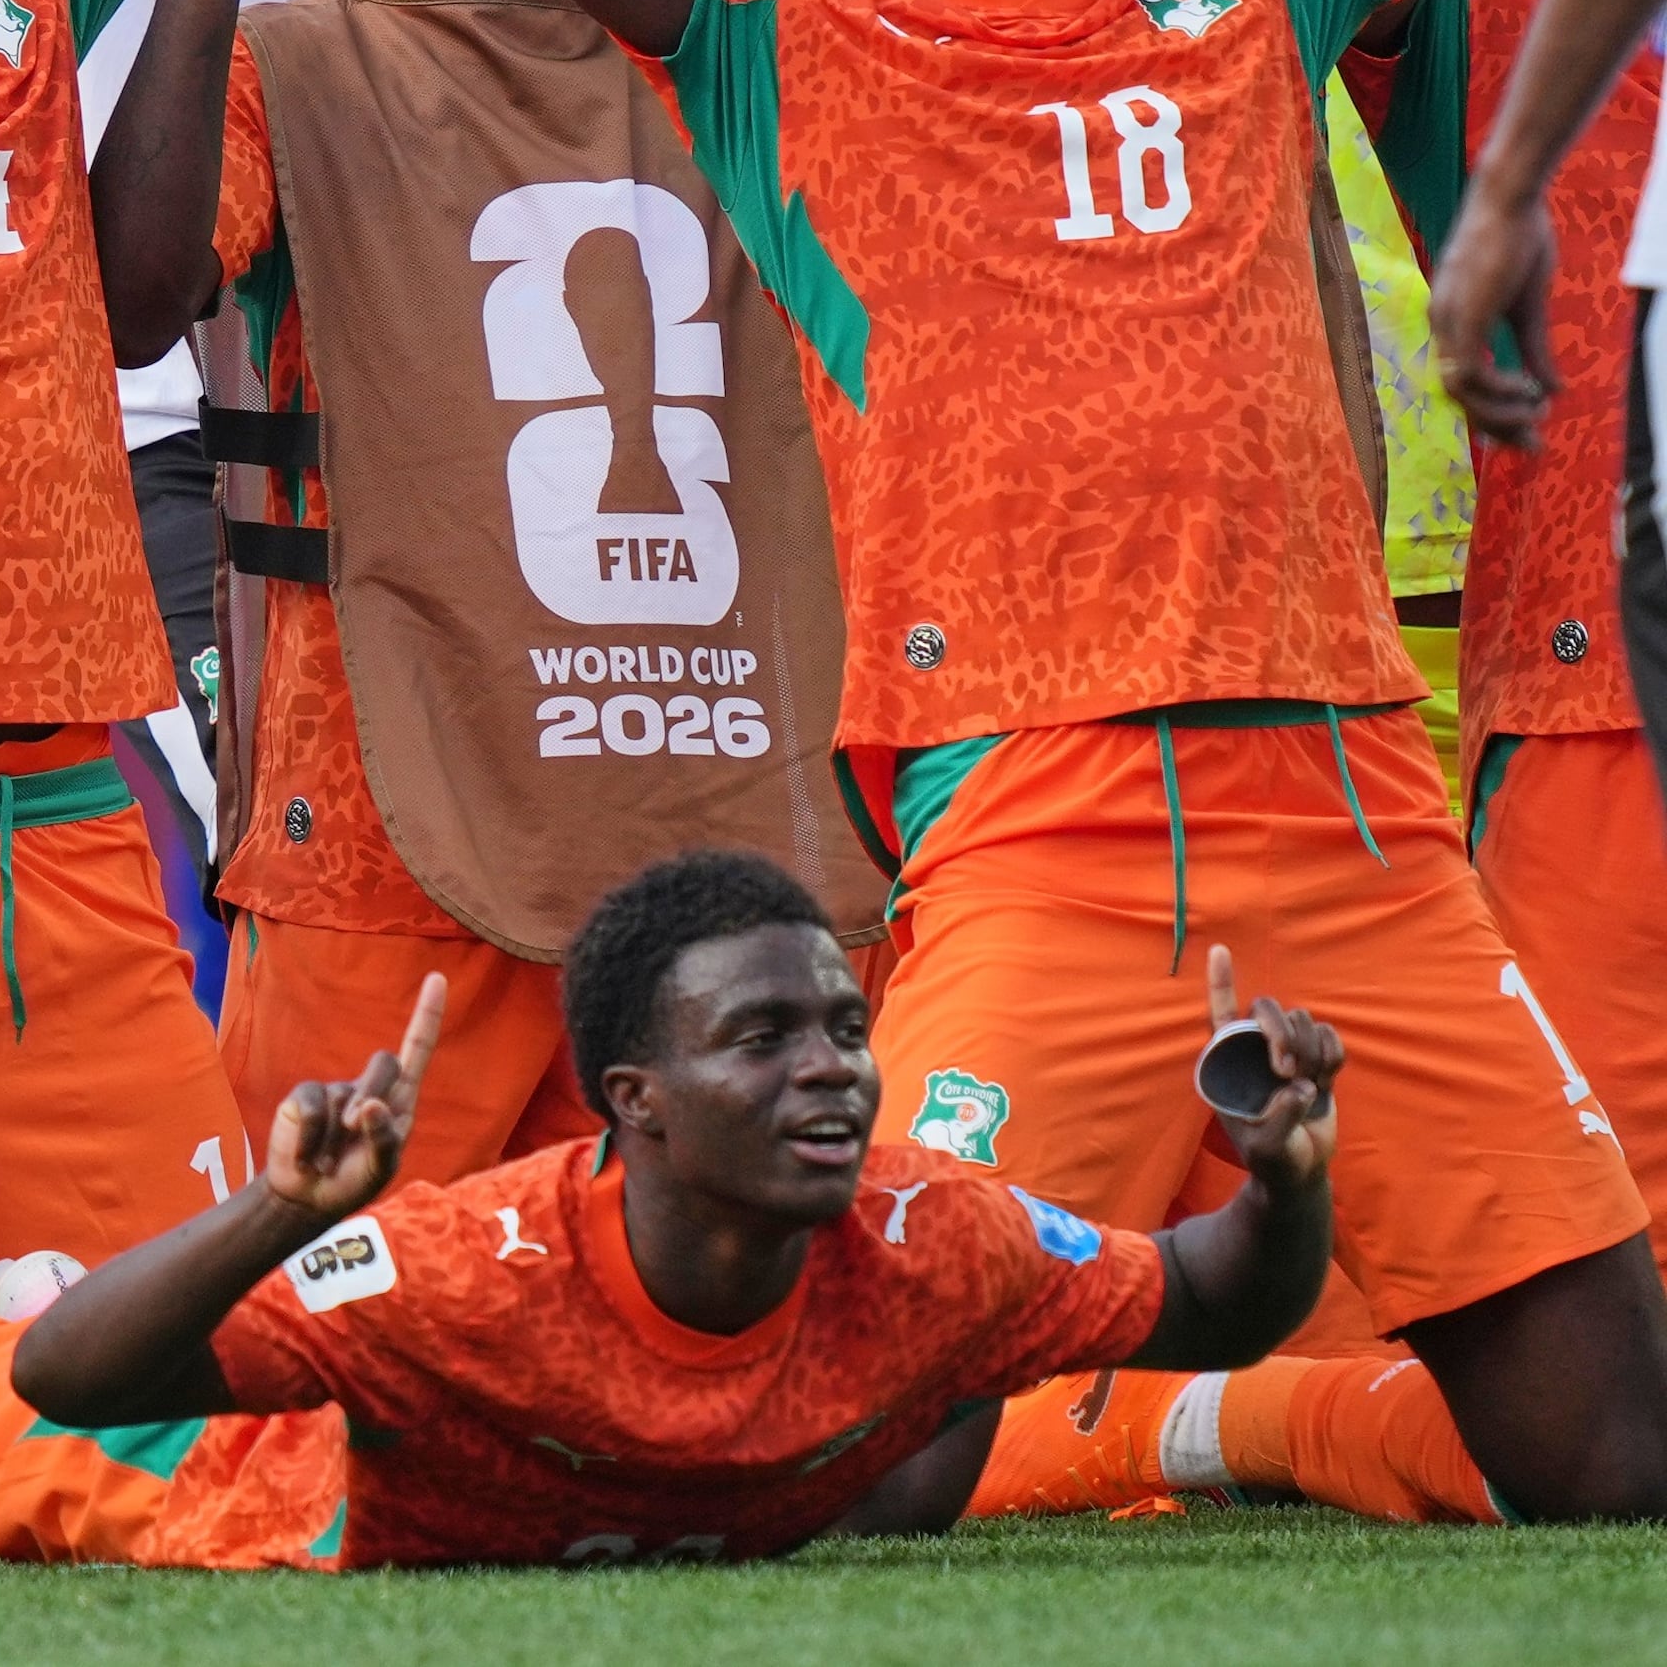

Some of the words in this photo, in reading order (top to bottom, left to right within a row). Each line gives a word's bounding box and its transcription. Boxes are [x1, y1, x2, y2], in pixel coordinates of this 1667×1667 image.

[1027, 84, 1194, 242] 18
[595, 536, 699, 584] FIFA
[528, 644, 687, 685] WORLD
[688, 646, 758, 685] CUP
[535, 693, 772, 759] 2026
